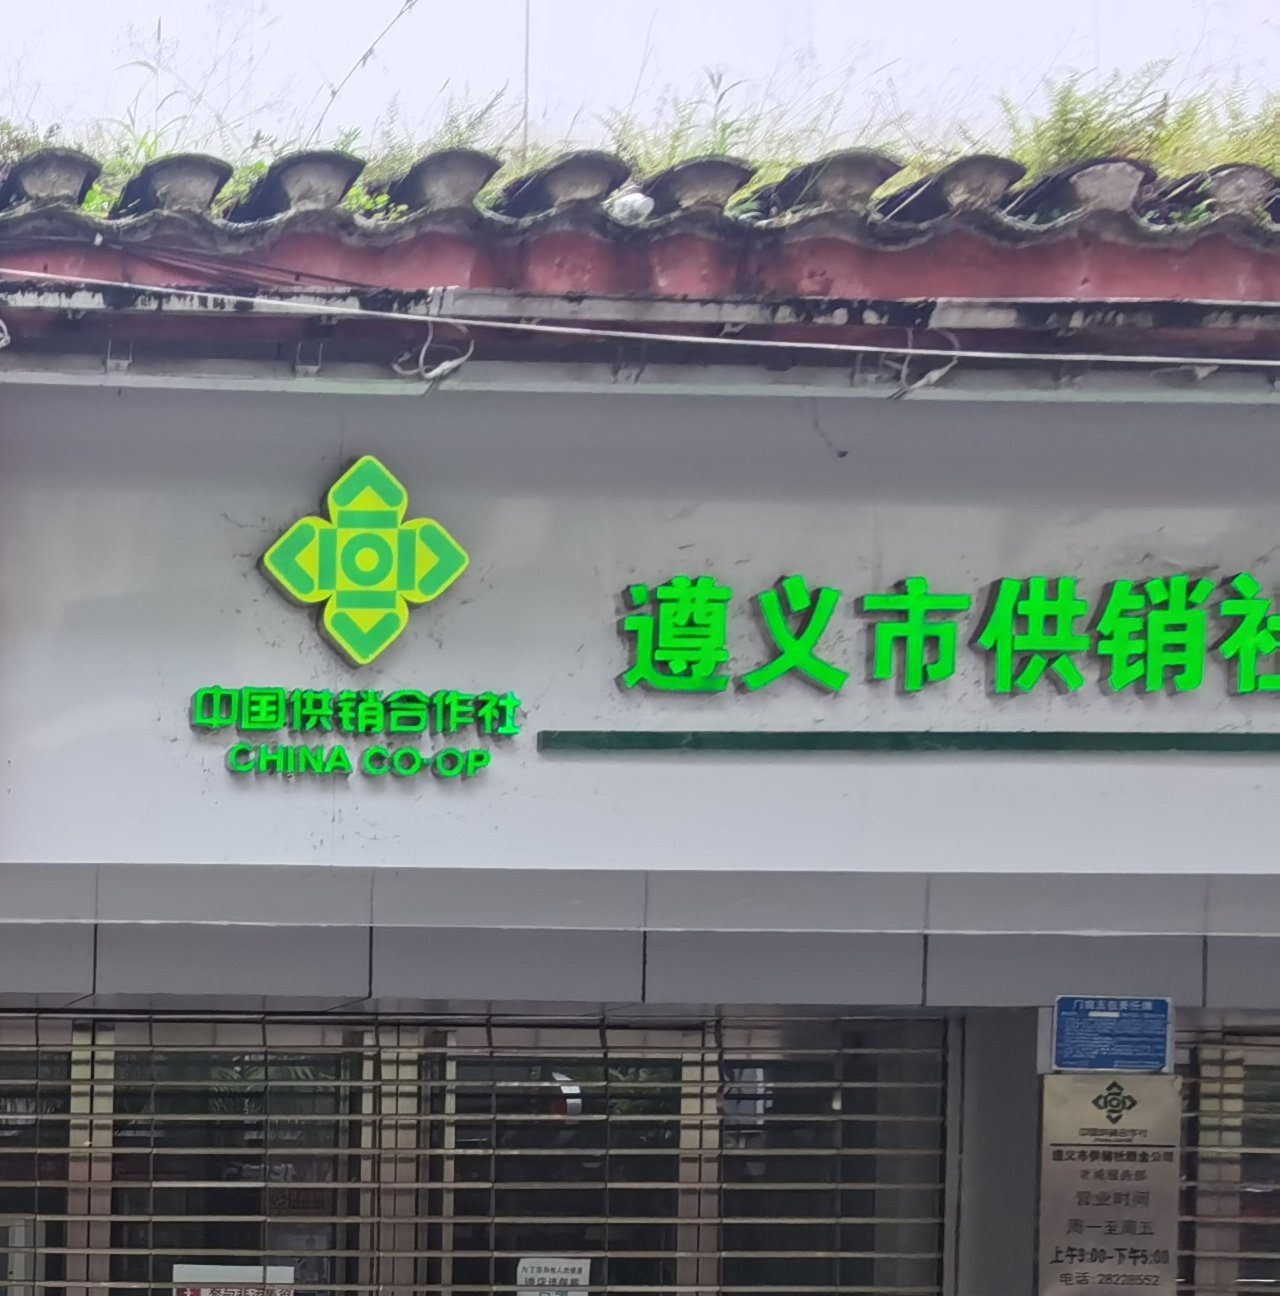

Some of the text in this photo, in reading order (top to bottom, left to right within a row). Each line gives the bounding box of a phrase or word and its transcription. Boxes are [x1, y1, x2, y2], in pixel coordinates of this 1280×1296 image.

[191, 685, 523, 736] 中国供销合作社
[226, 743, 493, 777] CHINA CO-OP
